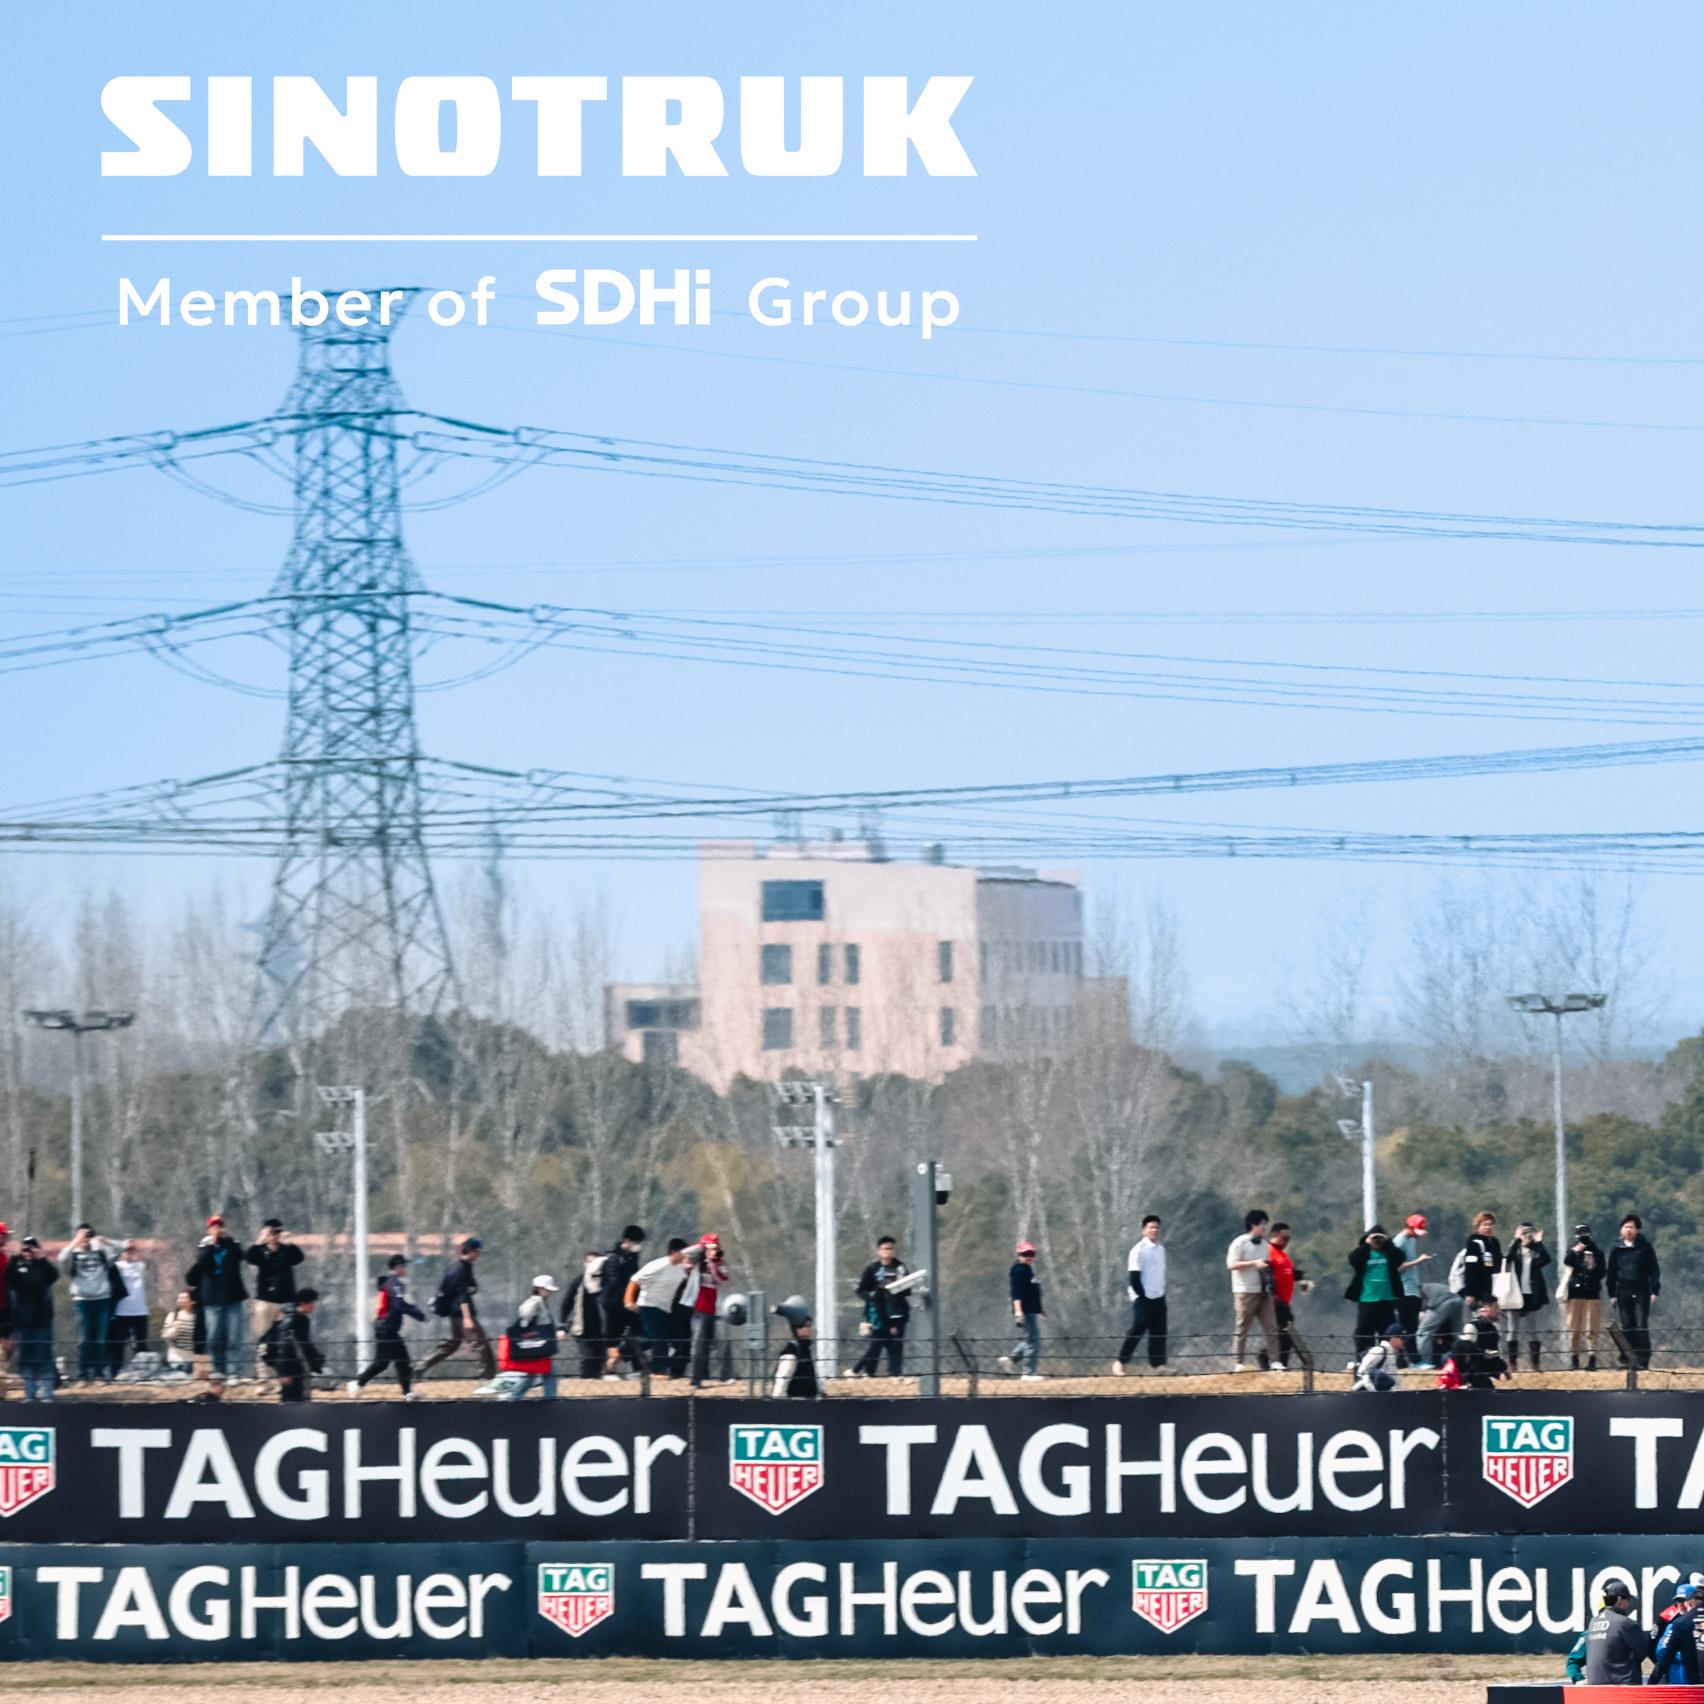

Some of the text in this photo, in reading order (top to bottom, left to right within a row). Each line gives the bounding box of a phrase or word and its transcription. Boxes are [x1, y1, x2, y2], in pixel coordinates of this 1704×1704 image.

[0, 1434, 46, 1460] AG
[737, 1431, 815, 1458] TAG
[1491, 1422, 1565, 1450] TAG
[734, 1466, 819, 1508] HEUER
[1488, 1457, 1568, 1500] HEUER
[545, 1569, 607, 1591] TAG
[1138, 1565, 1200, 1588] TAG
[543, 1598, 609, 1632] HEUER
[1136, 1594, 1203, 1629] HEUER
